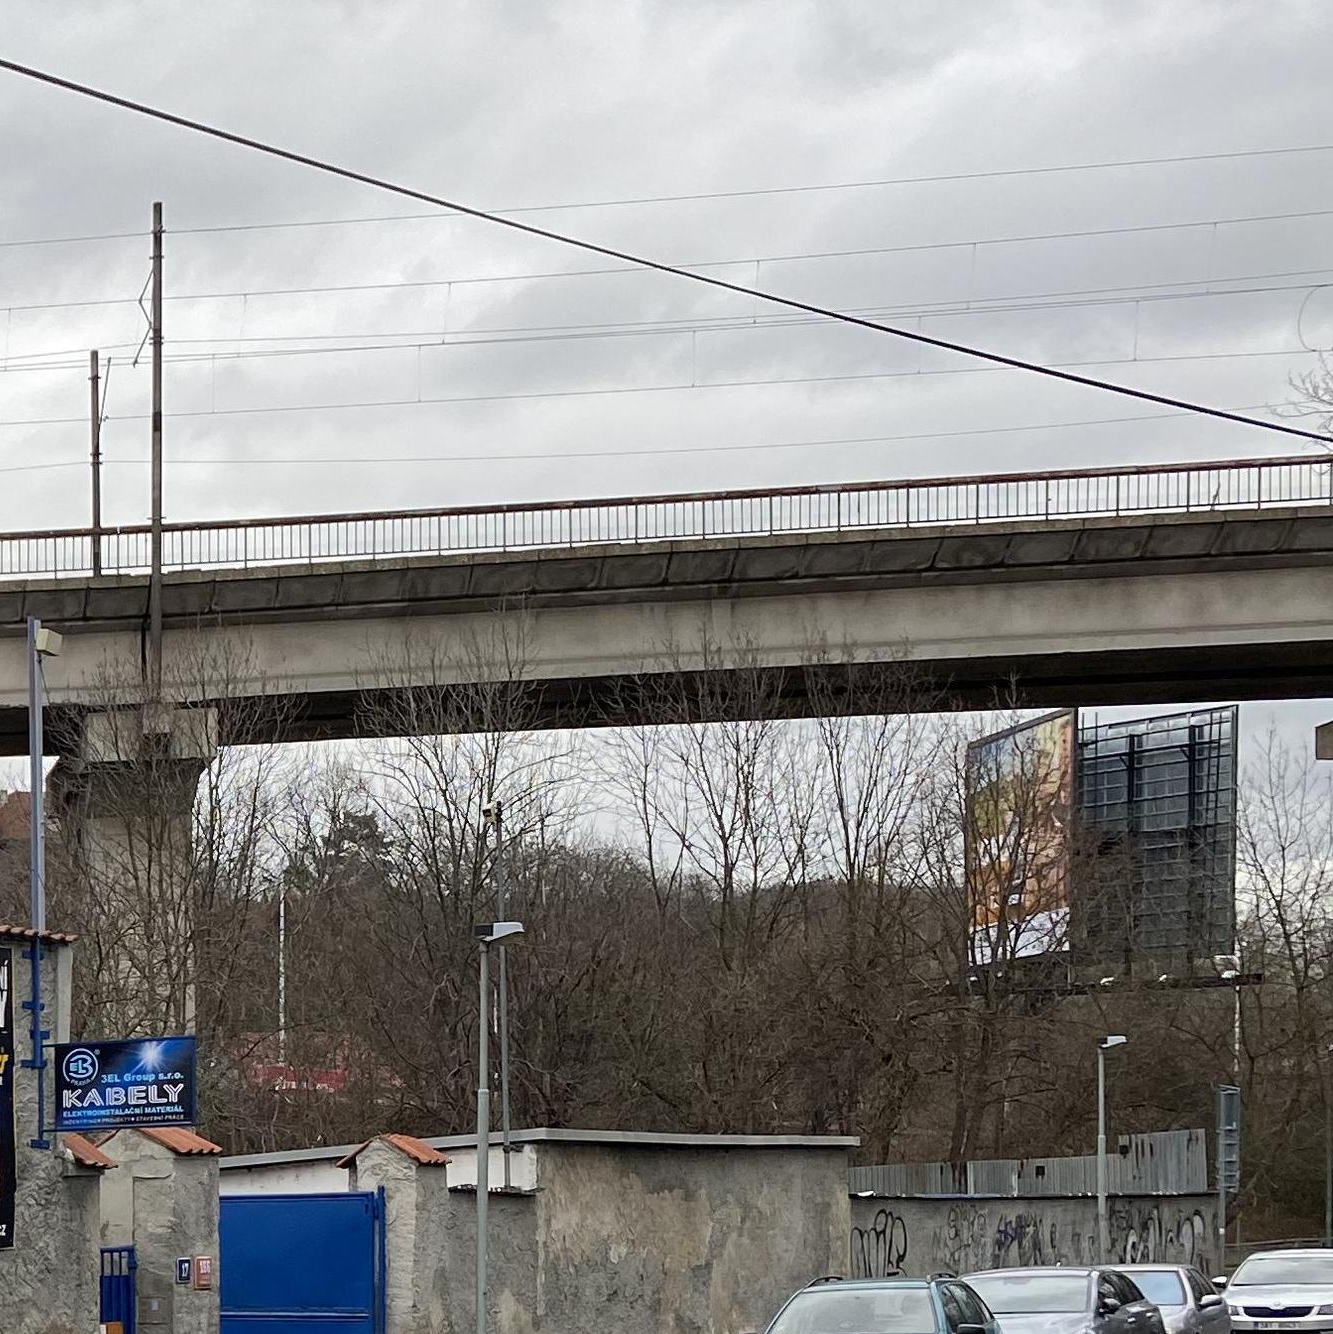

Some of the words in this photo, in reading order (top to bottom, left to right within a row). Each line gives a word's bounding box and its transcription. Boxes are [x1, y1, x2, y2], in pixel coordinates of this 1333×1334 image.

[101, 1073, 121, 1084] 3EL
[123, 1072, 155, 1083] Group
[158, 1071, 184, 1080] s.r.o.
[62, 1083, 184, 1109] KABELY
[181, 1262, 189, 1277] 17
